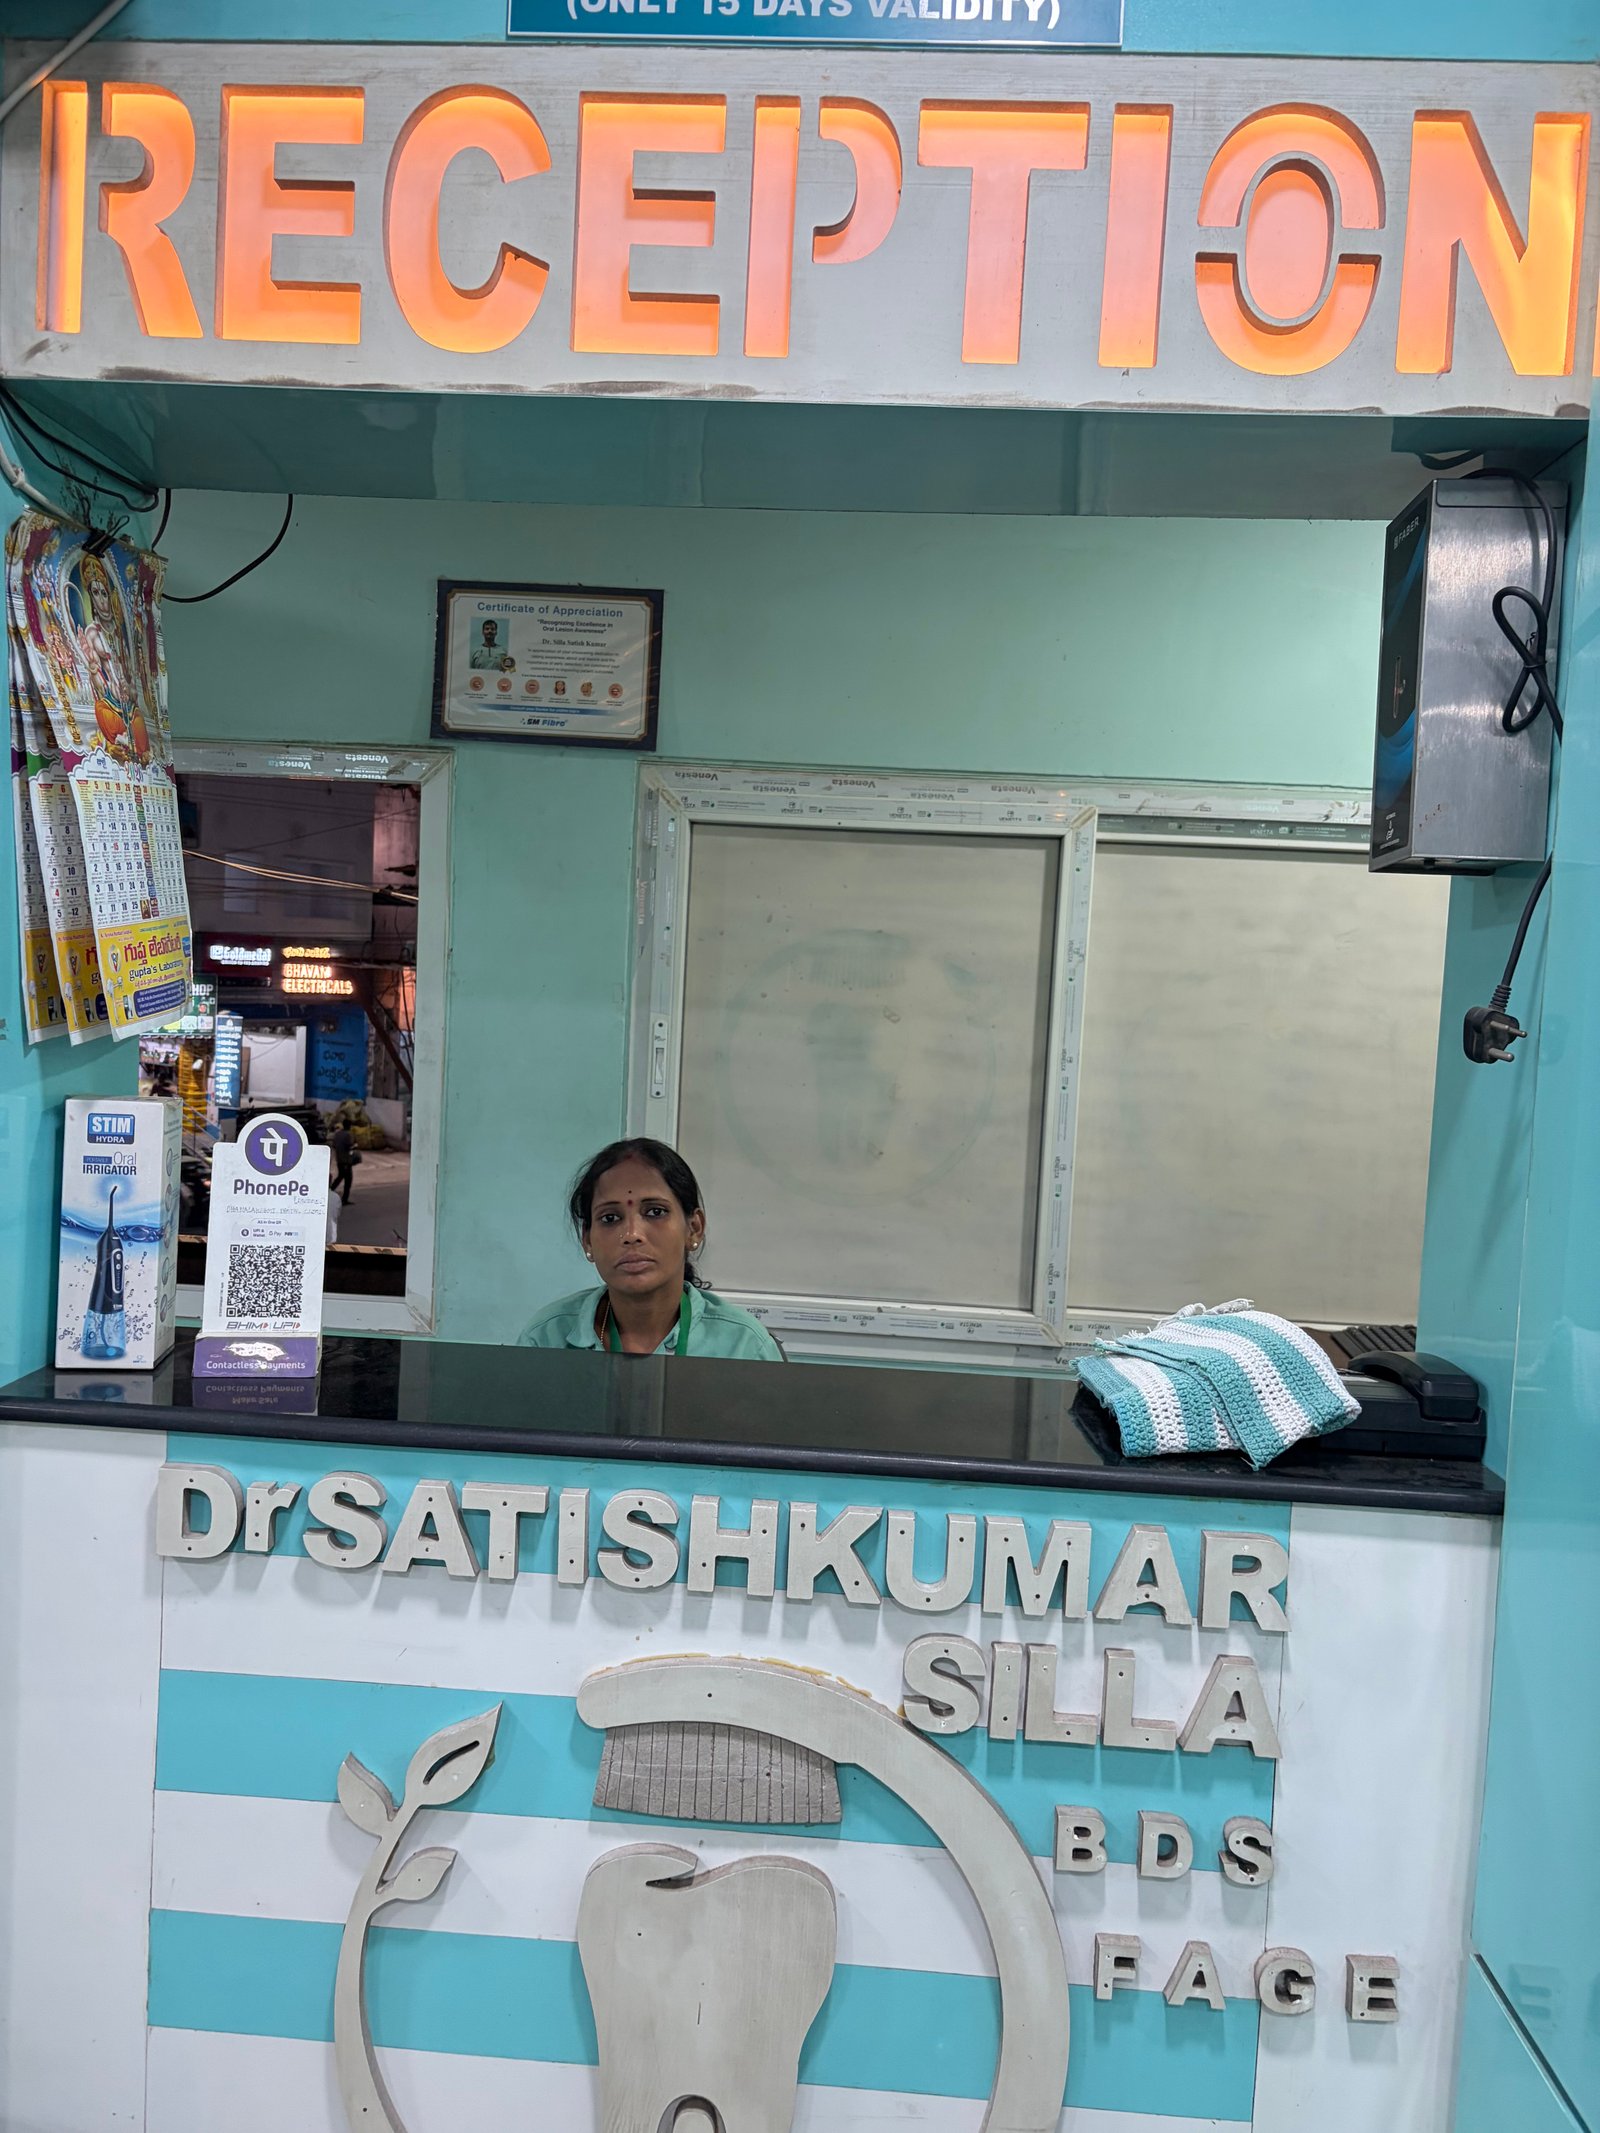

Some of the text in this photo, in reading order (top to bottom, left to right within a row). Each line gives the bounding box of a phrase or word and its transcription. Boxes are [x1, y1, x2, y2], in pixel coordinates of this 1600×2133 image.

[753, 0, 853, 17] DAYS
[867, 0, 1061, 30] VALIDITY)
[35, 79, 1592, 377] RECEPTION
[1398, 516, 1419, 544] FABER
[477, 601, 624, 618] Certificate of Appreciation
[344, 754, 389, 764] Venesta
[267, 760, 312, 771] Venesta
[61, 784, 66, 793] 6
[94, 780, 99, 790] 5
[105, 781, 110, 790] 12
[674, 771, 1036, 795] Venesta Venesta Venesta
[752, 785, 954, 801] Venesta Venesta
[98, 801, 102, 810] 6
[65, 825, 70, 834] 8
[121, 822, 127, 831] 21
[50, 846, 72, 856] 2 9
[113, 842, 119, 851] 15
[124, 842, 130, 850] 22
[52, 867, 76, 876] 3 10
[94, 863, 98, 872] 2
[106, 863, 109, 871] 9
[55, 887, 77, 897] 4 11
[96, 884, 100, 893] 3
[119, 882, 124, 891] 17
[129, 881, 135, 890] 24
[57, 907, 79, 917] 5 12
[99, 905, 103, 913] 4
[111, 904, 116, 912] 11
[132, 901, 138, 910] 25
[129, 965, 158, 982] gupta's
[189, 984, 213, 996] HOP
[283, 978, 354, 994] ELECTRICALS
[92, 1116, 131, 1133] STIM
[95, 1135, 125, 1143] HYDRA
[259, 1127, 288, 1167] पे
[113, 1151, 137, 1165] Oral
[82, 1164, 137, 1176] IRRIGATOR
[233, 1178, 309, 1197] PhonePe
[226, 1321, 264, 1329] BHIM
[206, 1360, 259, 1370] Contactless
[902, 1633, 1282, 1759] SILLA
